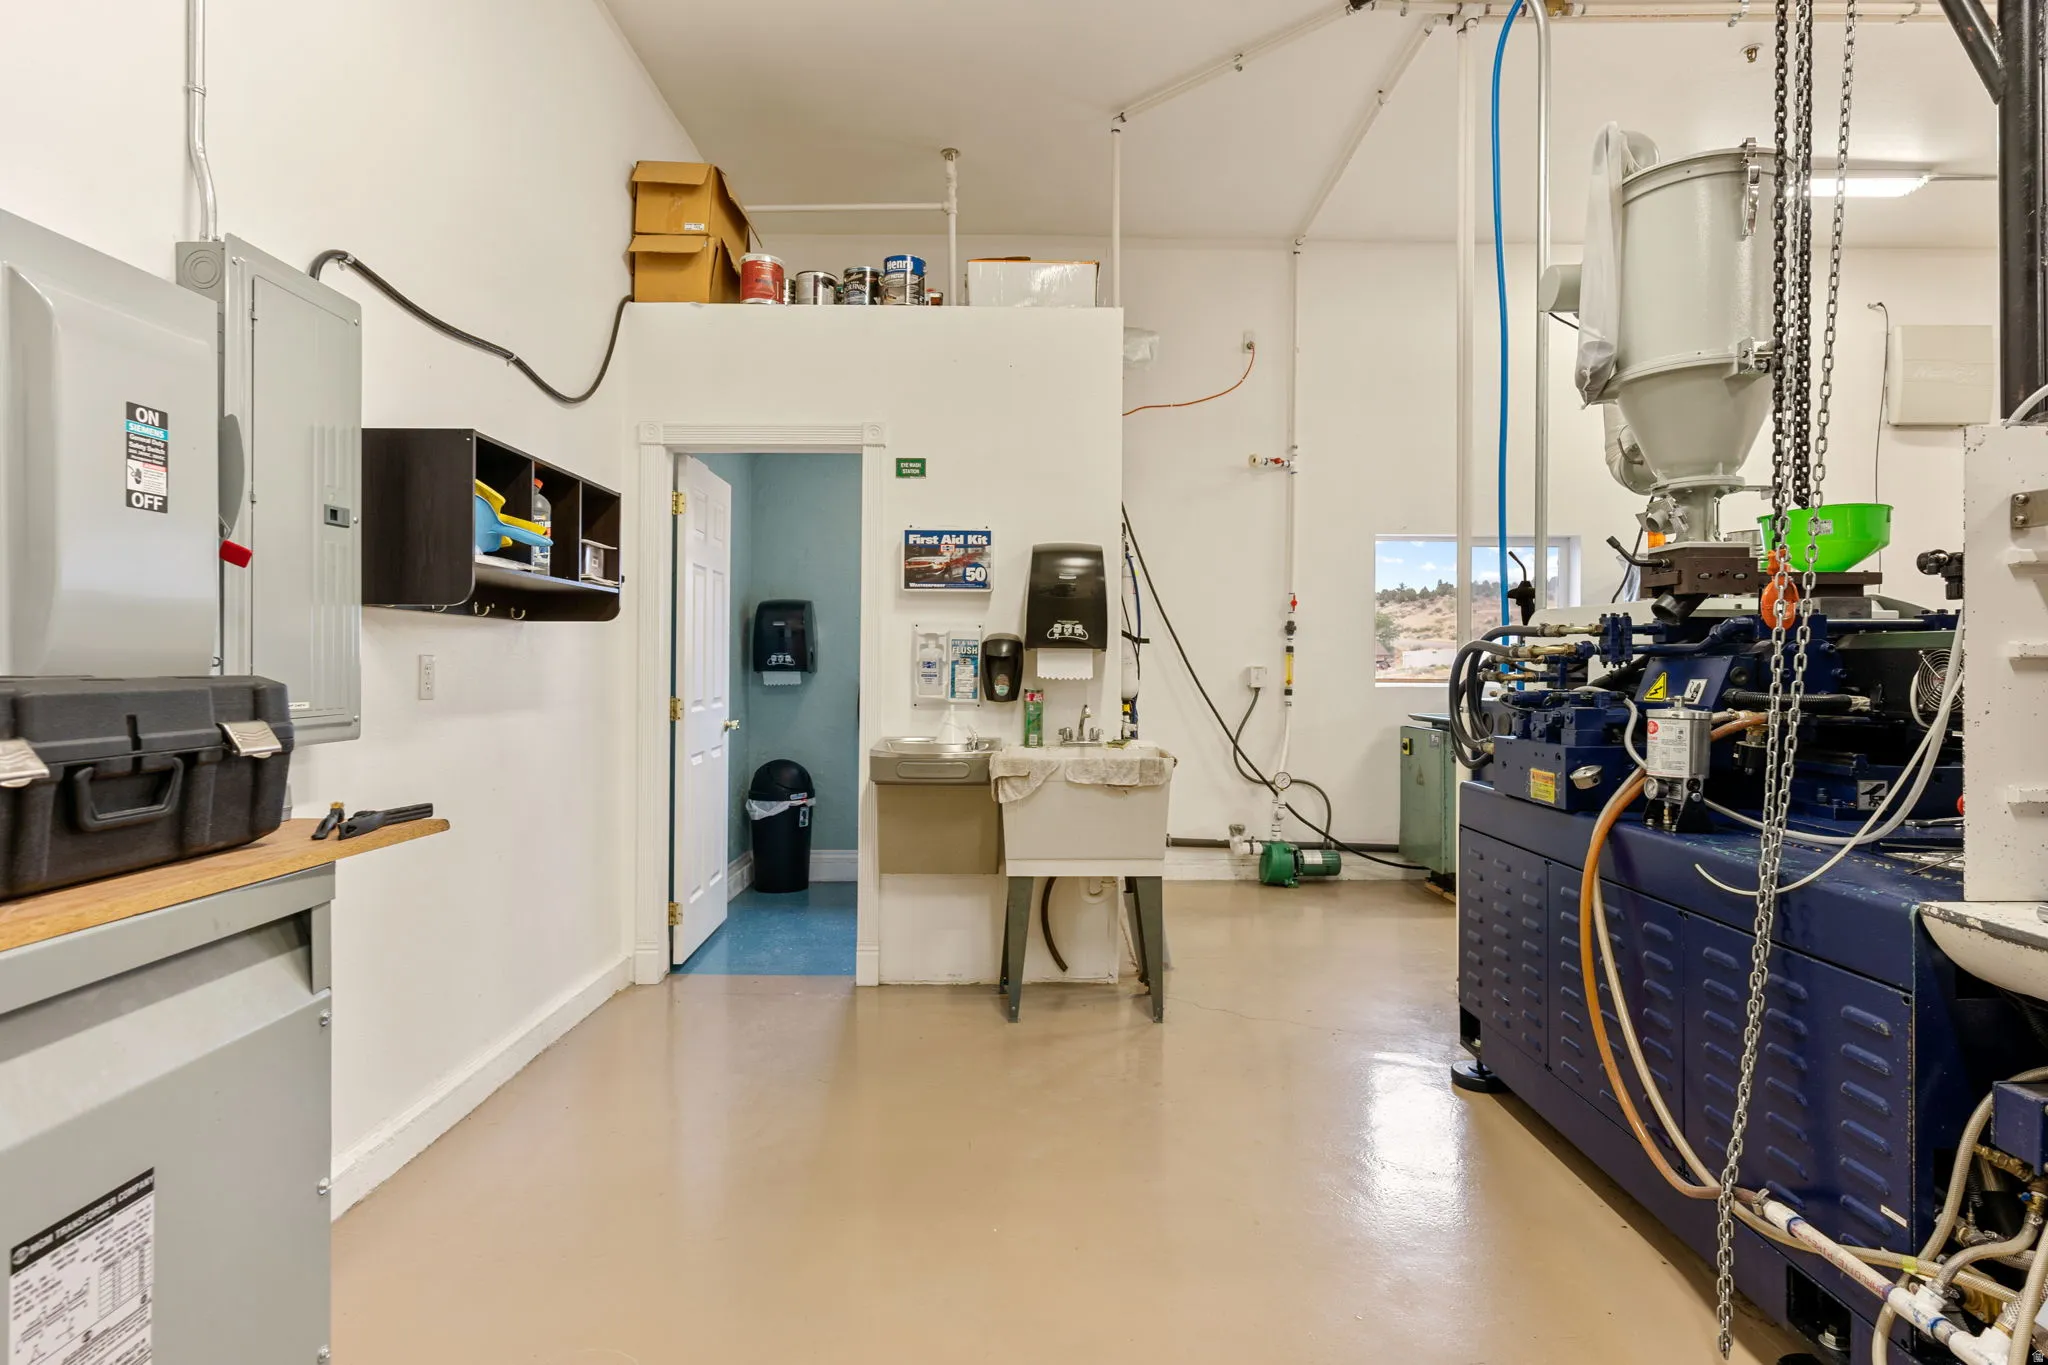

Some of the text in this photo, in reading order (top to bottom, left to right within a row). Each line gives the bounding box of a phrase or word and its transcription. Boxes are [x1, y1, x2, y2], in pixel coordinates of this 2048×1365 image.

[887, 260, 914, 271] Henry
[135, 407, 160, 427] ON
[128, 422, 165, 438] SIEMENS
[131, 491, 164, 511] OFF
[908, 534, 988, 545] First Aid Kit
[965, 566, 986, 582] 50
[952, 646, 978, 654] FLUSH
